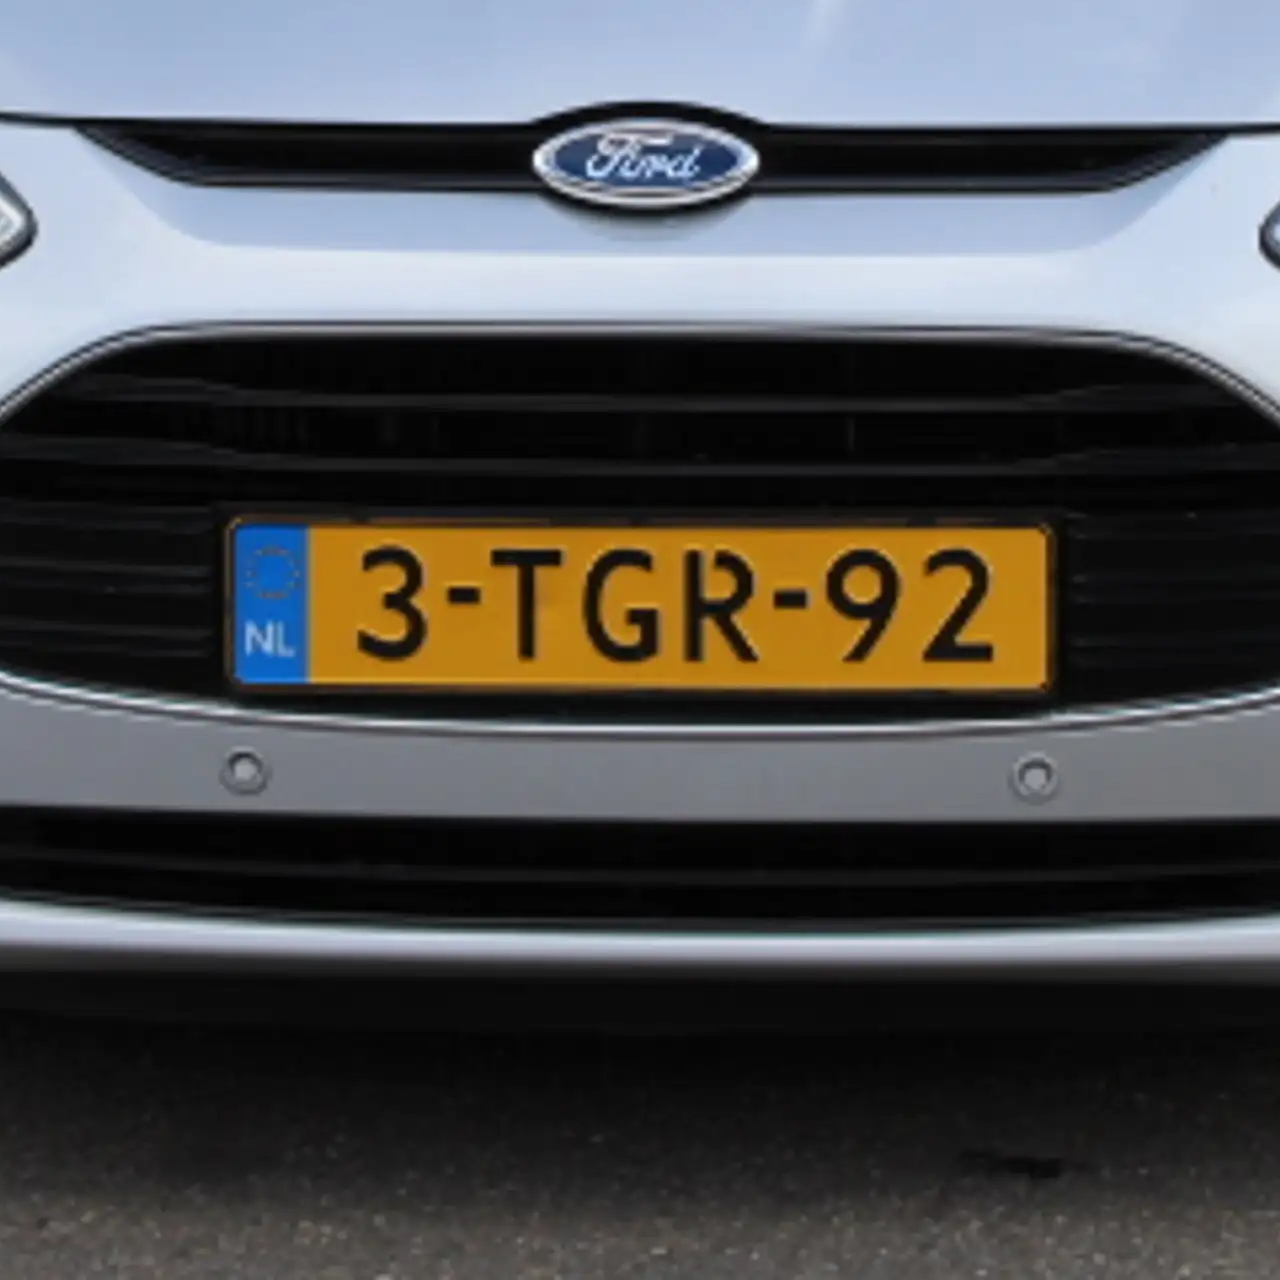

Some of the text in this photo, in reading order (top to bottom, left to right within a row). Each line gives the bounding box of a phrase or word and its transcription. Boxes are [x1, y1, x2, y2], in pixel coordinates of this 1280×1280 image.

[585, 132, 702, 180] Ford
[356, 545, 994, 663] 3-TGR-92
[244, 621, 295, 658] NL
